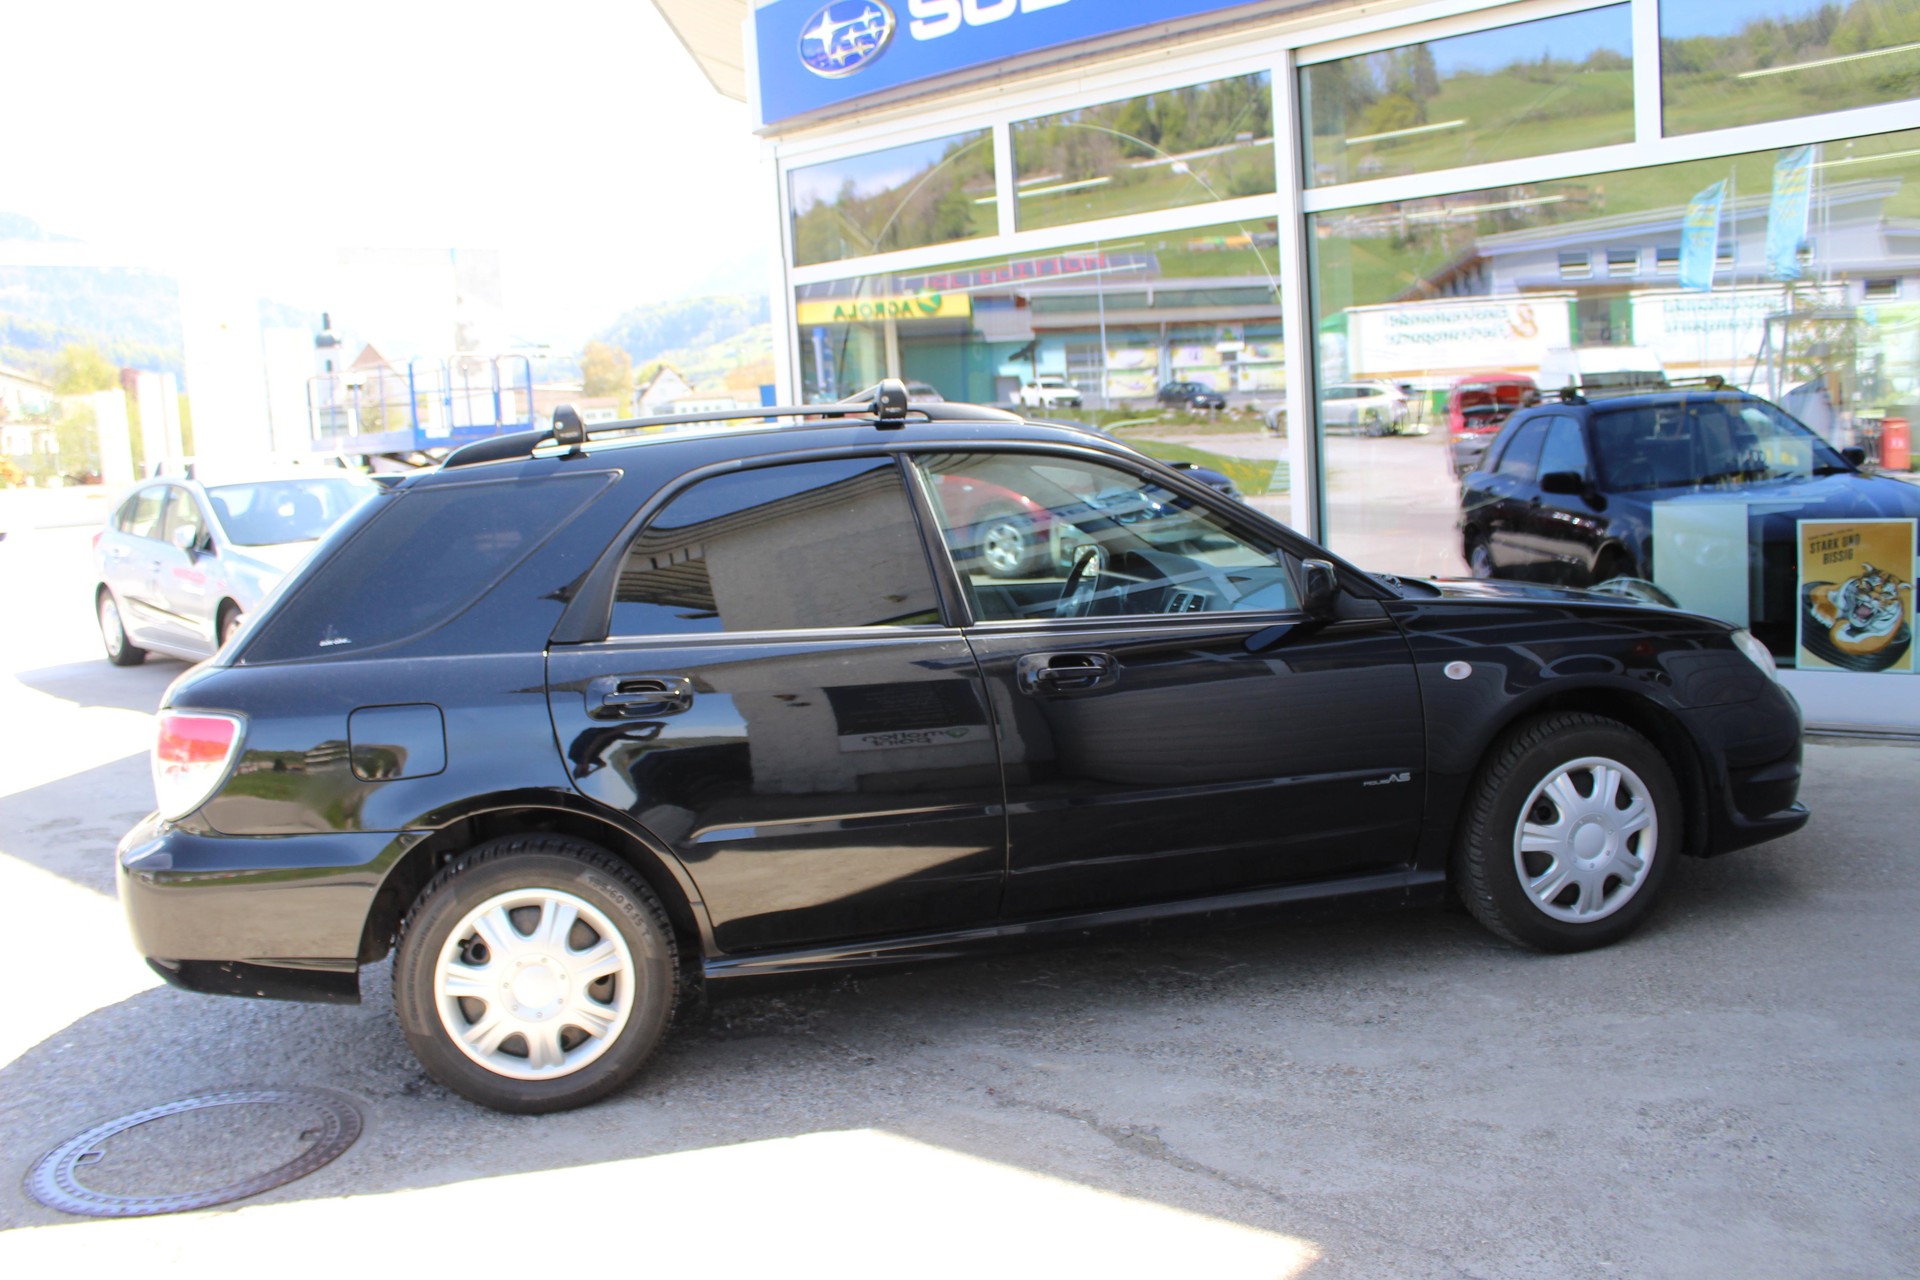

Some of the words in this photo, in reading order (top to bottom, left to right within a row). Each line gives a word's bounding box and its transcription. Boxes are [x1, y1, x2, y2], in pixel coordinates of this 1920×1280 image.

[1809, 537, 1839, 554] STARK
[1823, 548, 1854, 565] BISSIG
[623, 903, 634, 913] R
[632, 912, 645, 927] 15
